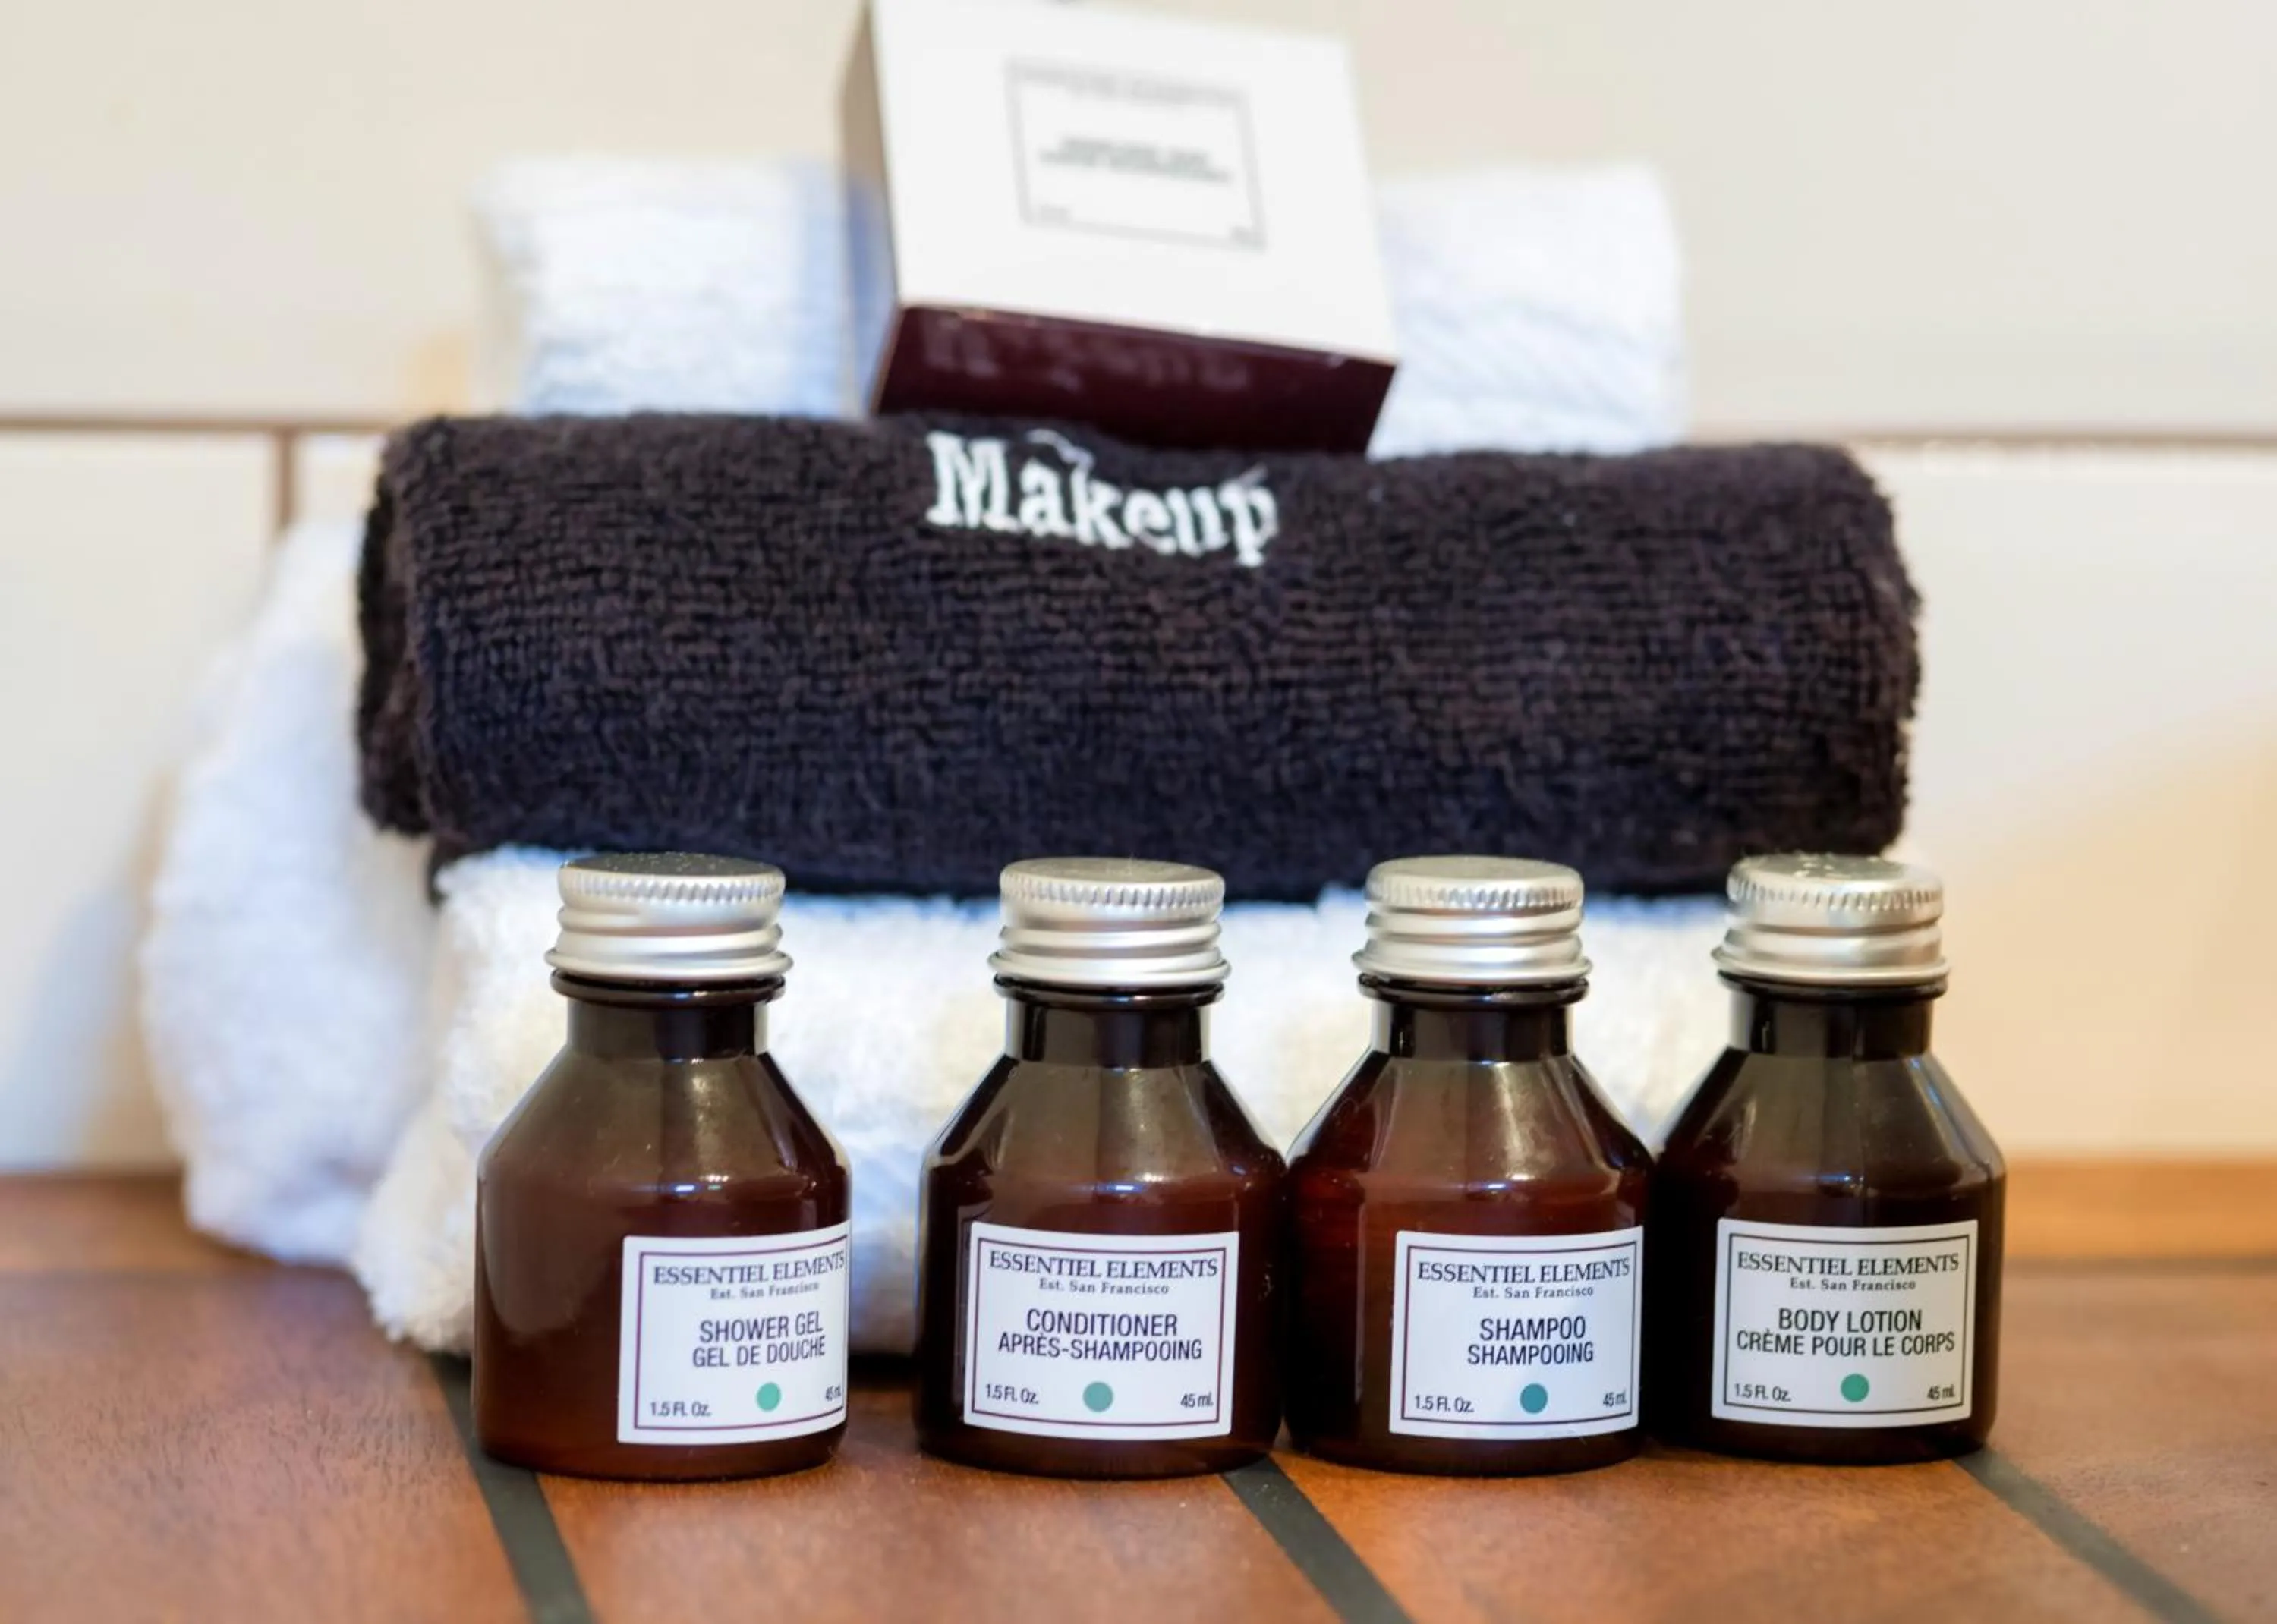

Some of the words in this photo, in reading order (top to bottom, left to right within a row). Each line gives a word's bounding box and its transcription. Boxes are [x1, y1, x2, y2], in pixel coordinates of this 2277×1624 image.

[926, 430, 1277, 567] Makeup
[653, 1265, 769, 1285] ESSENTIEL
[773, 1250, 845, 1282] ELEMENTS
[990, 1250, 1101, 1278] ESSENTIEL
[1107, 1258, 1219, 1279] ELEMENTS
[1418, 1261, 1535, 1283] ESSENTIEL
[1540, 1257, 1630, 1283] ELEMENTS
[1737, 1251, 1852, 1276] ESSENTIEL
[1857, 1253, 1959, 1276] ELEMENTS
[740, 1286, 764, 1298] San
[769, 1281, 820, 1298] Francisco
[1039, 1278, 1064, 1292] Est.
[1069, 1280, 1095, 1294] San
[1101, 1281, 1170, 1295] Francisco
[1473, 1286, 1499, 1298] Est.
[1504, 1286, 1530, 1298] San
[1535, 1286, 1594, 1298] Francisco
[1790, 1278, 1815, 1290] Est.
[1821, 1279, 1847, 1290] San
[1852, 1279, 1916, 1291] Francisco
[699, 1315, 789, 1343] SHOWER
[795, 1311, 823, 1336] GEL
[1026, 1308, 1178, 1337] CONDITIONER
[1479, 1315, 1586, 1341] SHAMPOO
[1778, 1308, 1840, 1333] BODY
[1847, 1309, 1922, 1333] LOTION
[692, 1346, 729, 1367] GEL
[736, 1345, 760, 1365] DE
[767, 1336, 826, 1364] DOUCHE
[998, 1332, 1202, 1361] APRÈS-SHAMPOOING
[1467, 1342, 1594, 1365] SHAMPOOING
[1737, 1329, 1804, 1355] CRÈME
[1812, 1336, 1866, 1357] POUR
[1872, 1336, 1895, 1356] LE
[1901, 1332, 1955, 1355] CORPS
[986, 1383, 1002, 1399] 1.5
[1021, 1388, 1039, 1404] Oz.
[1180, 1393, 1195, 1408] 45
[1415, 1395, 1434, 1411] 1.5
[1454, 1397, 1474, 1412] Oz.
[1603, 1392, 1614, 1407] 45
[1734, 1383, 1753, 1399] 1.5
[1772, 1386, 1791, 1402] Oz.
[1927, 1385, 1940, 1400] 45
[650, 1402, 670, 1416] 1.5
[691, 1401, 712, 1417] Oz.
